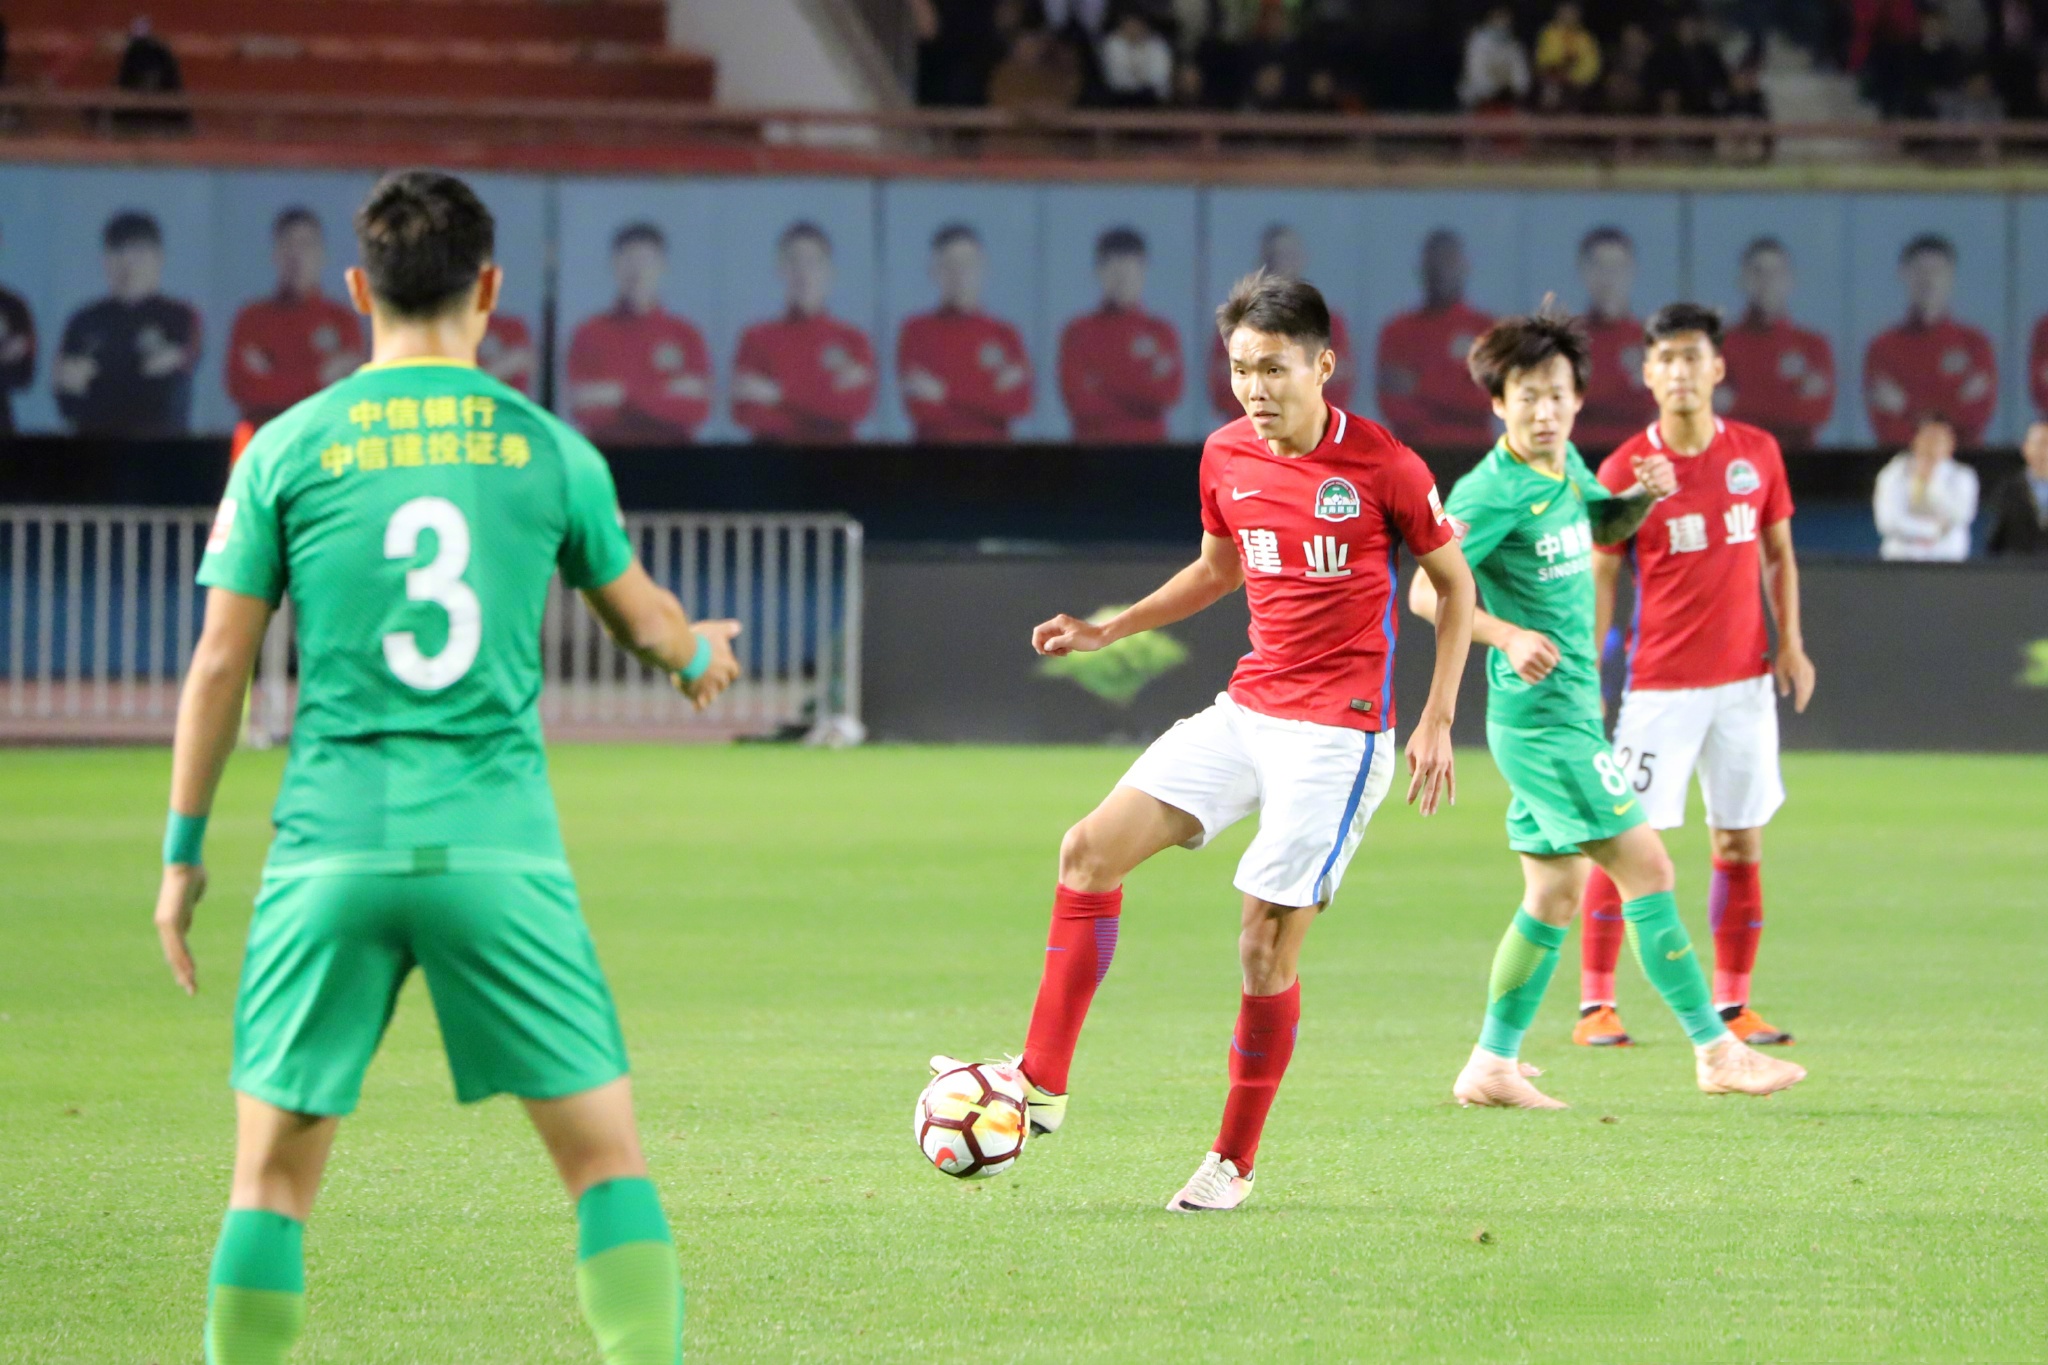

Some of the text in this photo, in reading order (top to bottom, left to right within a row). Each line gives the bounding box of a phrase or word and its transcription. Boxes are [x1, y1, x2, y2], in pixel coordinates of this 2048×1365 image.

[349, 395, 496, 431] 中信银行
[321, 431, 531, 477] 中信建投证券
[1238, 528, 1351, 578] 建业
[1666, 503, 1758, 555] 建业
[382, 496, 482, 690] 3
[1619, 746, 1656, 793] 25
